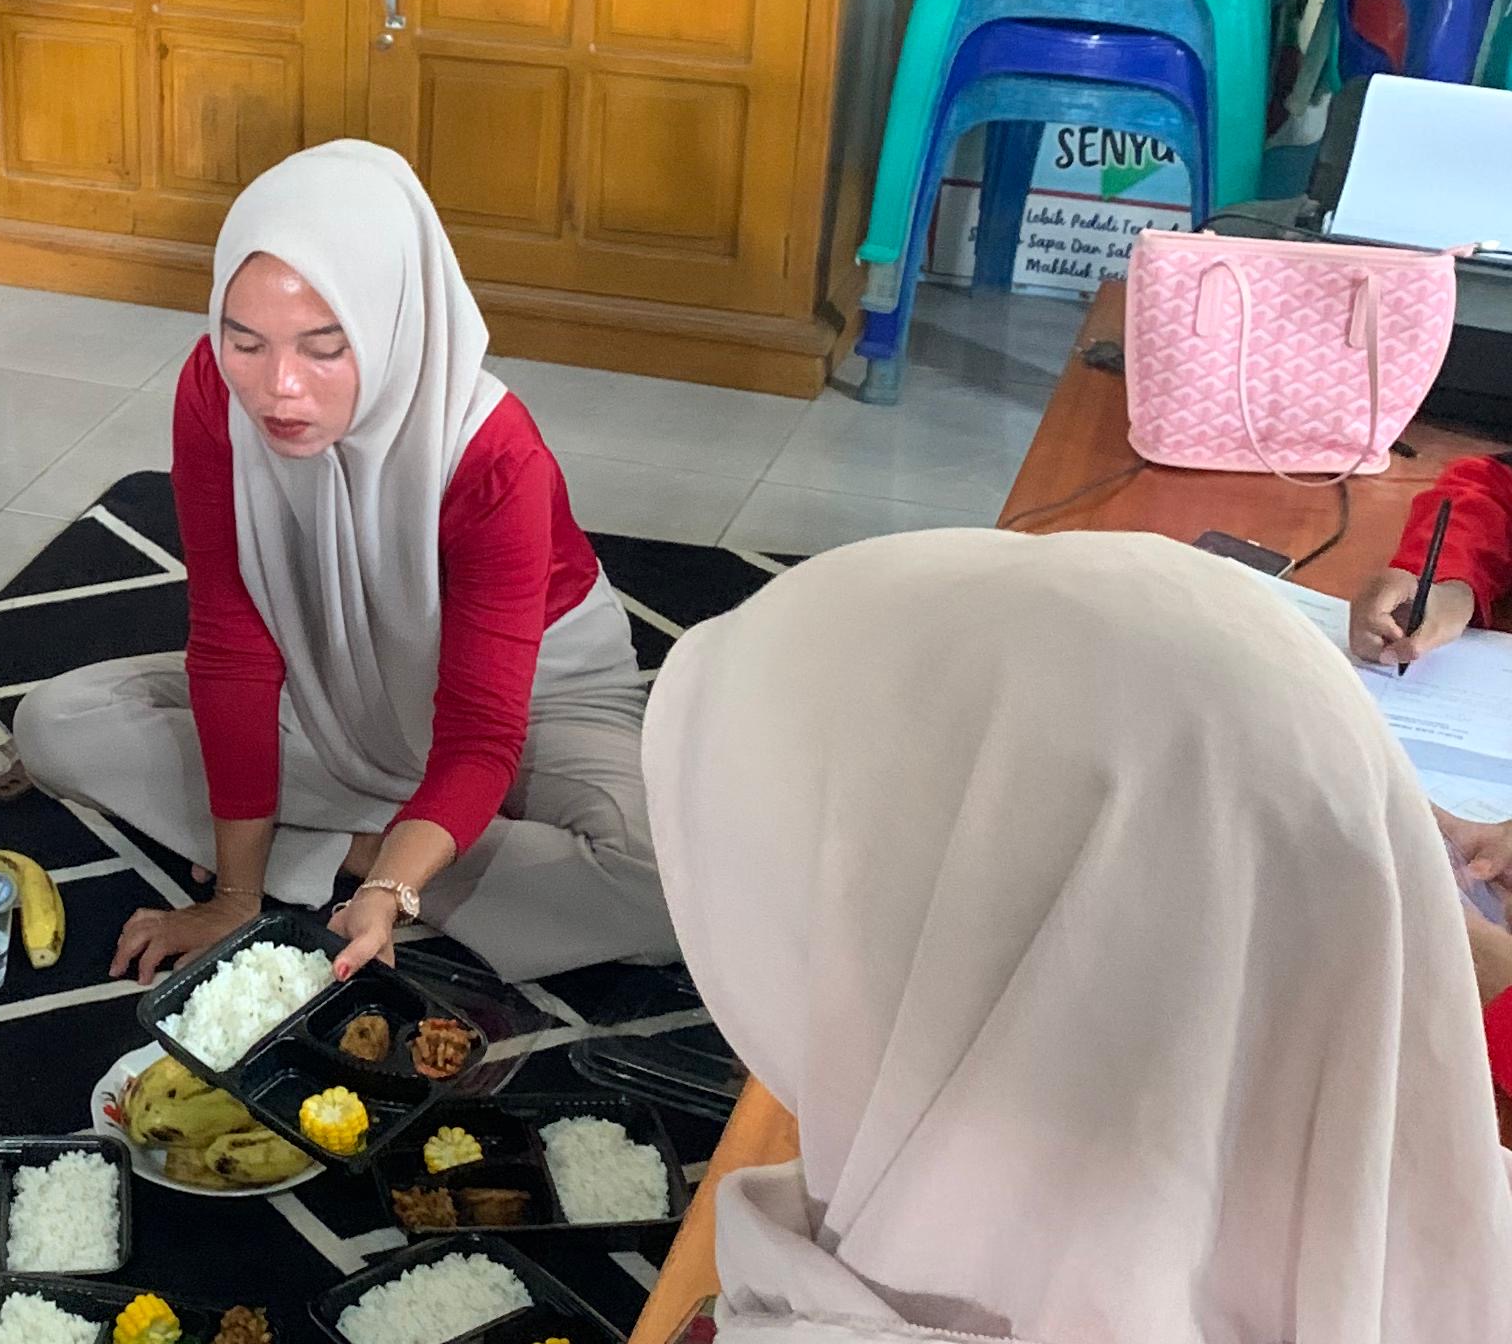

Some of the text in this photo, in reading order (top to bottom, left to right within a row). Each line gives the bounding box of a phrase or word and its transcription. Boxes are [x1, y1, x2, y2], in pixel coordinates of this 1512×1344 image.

[1055, 125, 1176, 169] SENYU
[1027, 207, 1066, 226] Lebih
[1071, 213, 1119, 233] Peduli
[1028, 233, 1066, 253] Sapa
[1071, 238, 1102, 254] Dan
